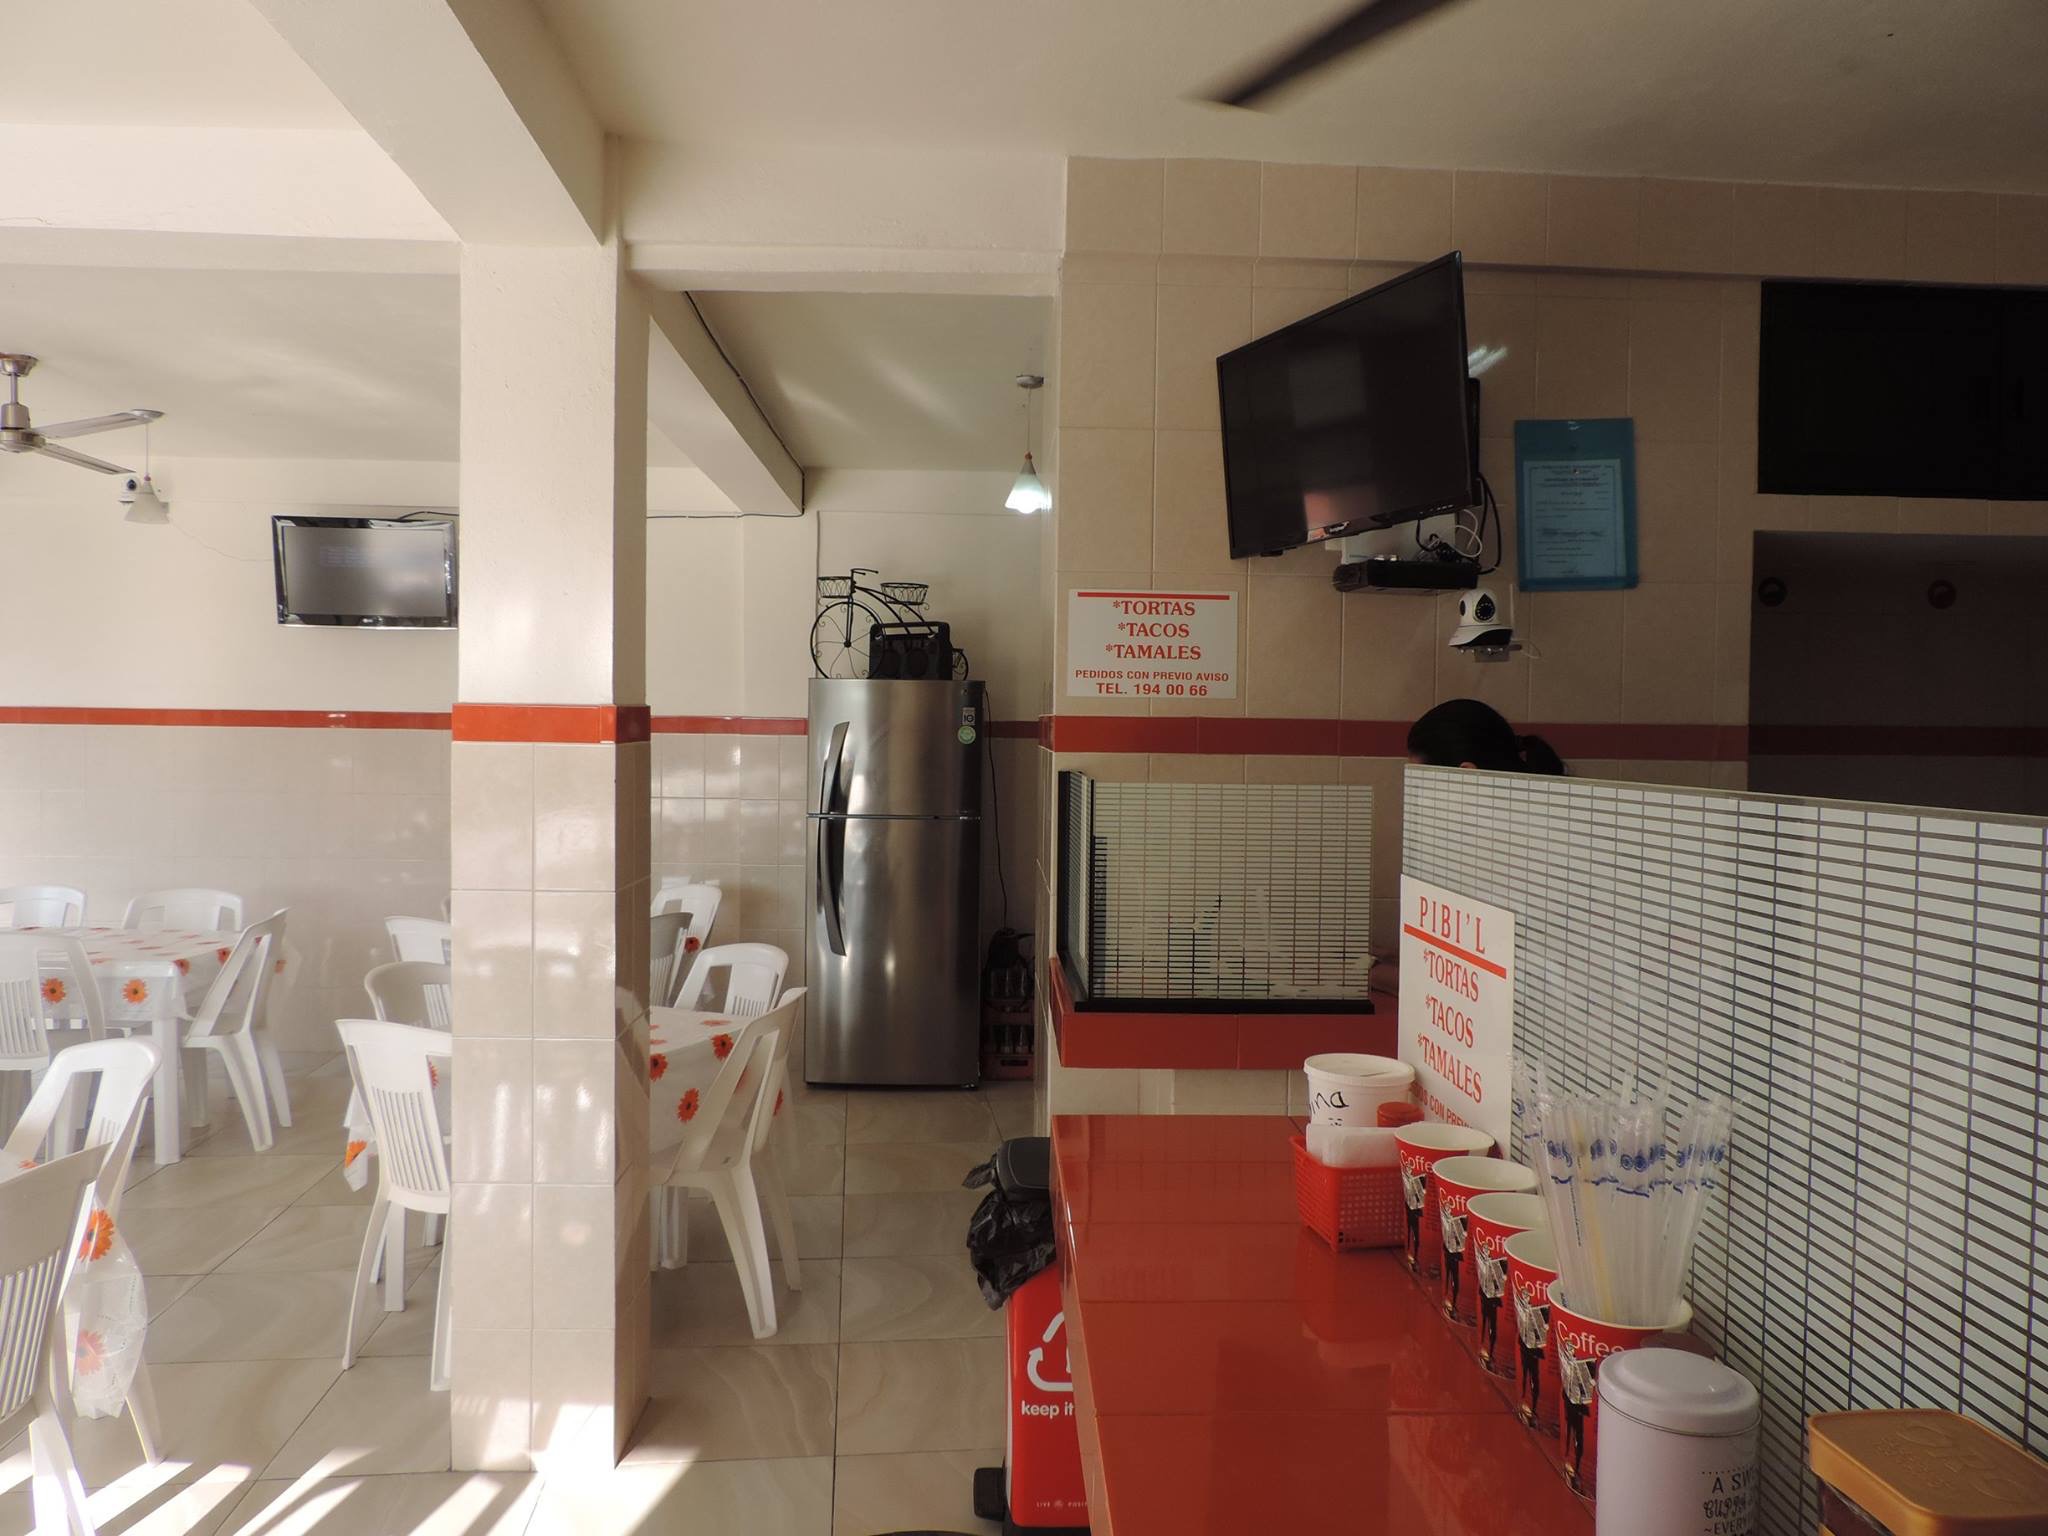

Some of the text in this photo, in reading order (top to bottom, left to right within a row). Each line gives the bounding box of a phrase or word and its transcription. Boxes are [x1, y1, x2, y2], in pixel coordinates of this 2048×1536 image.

[1075, 669, 1229, 682] PEDIDOS CON PREVIO AVISO
[1096, 682, 1208, 696] TEL. 194 00 66
[1419, 895, 1486, 954] PIBI'L
[1430, 1095, 1445, 1120] CON
[1021, 1400, 1074, 1418] keep it
[1712, 1476, 1724, 1494] A
